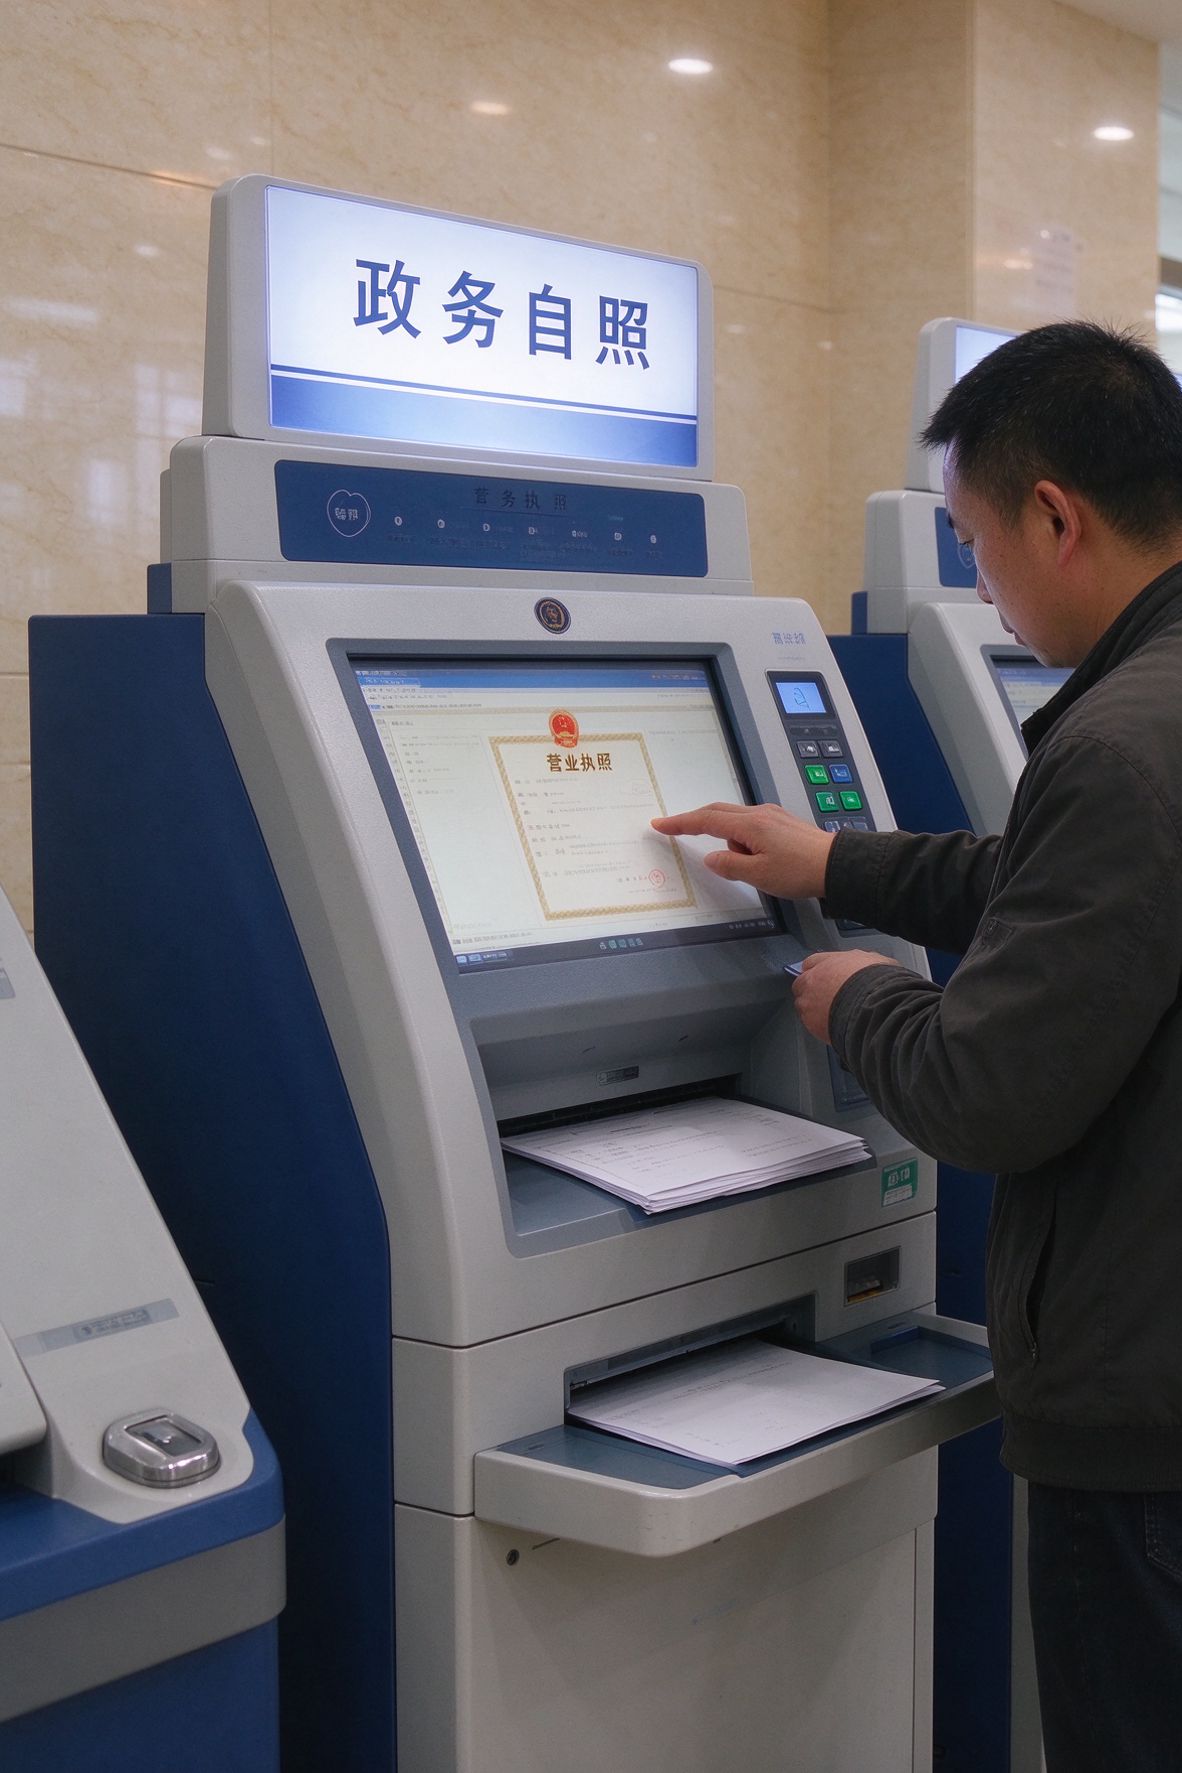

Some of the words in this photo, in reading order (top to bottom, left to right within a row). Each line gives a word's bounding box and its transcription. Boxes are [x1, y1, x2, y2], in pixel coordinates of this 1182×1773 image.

[353, 257, 651, 371] 政务自照
[546, 752, 613, 772] 营业执照
